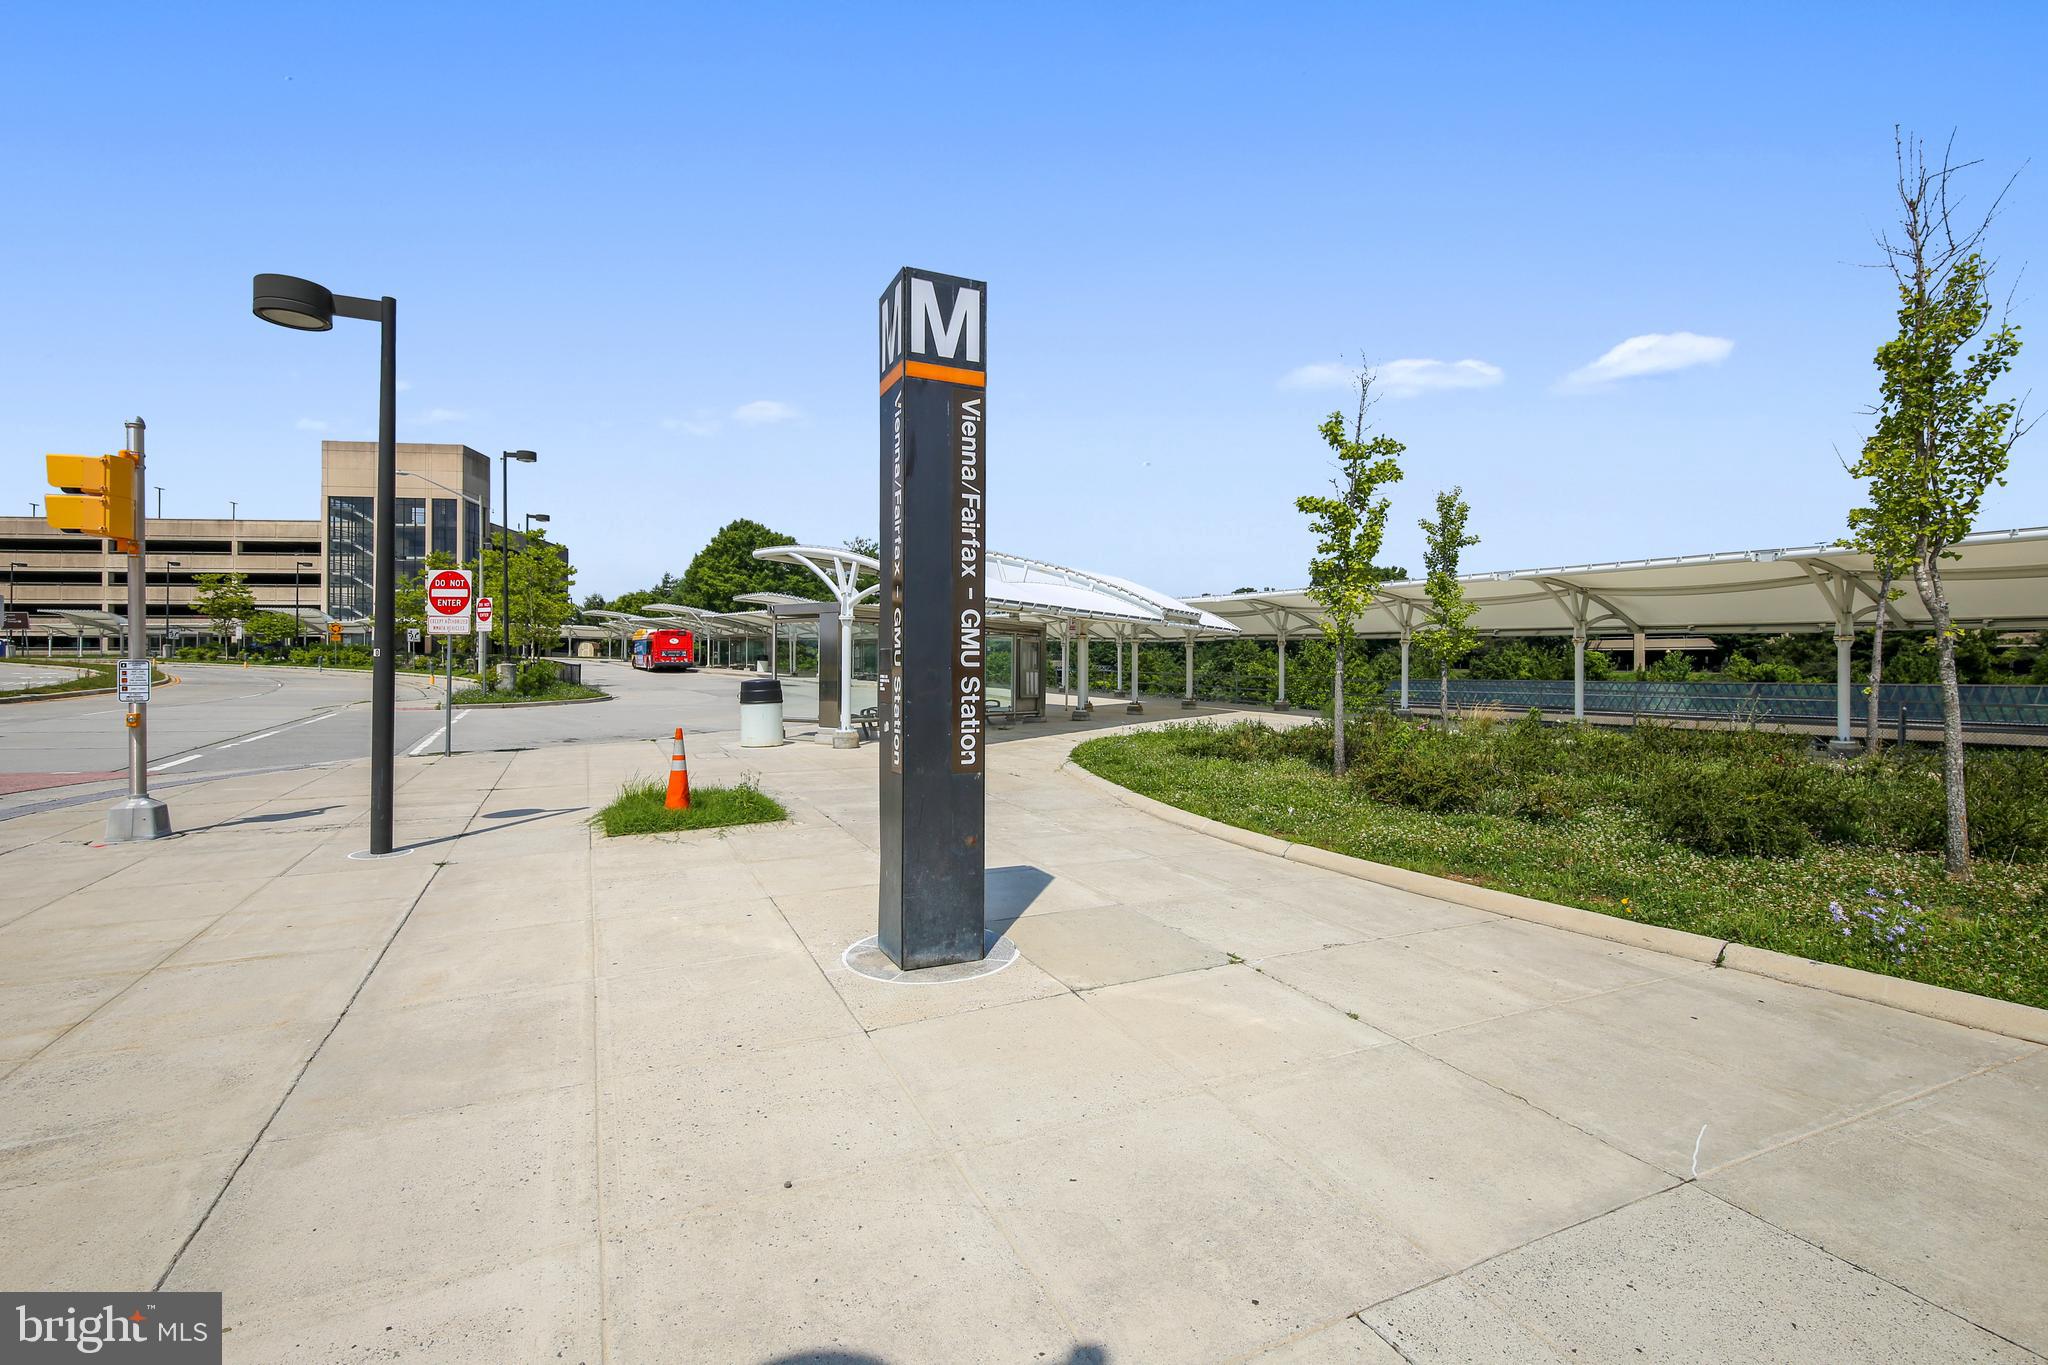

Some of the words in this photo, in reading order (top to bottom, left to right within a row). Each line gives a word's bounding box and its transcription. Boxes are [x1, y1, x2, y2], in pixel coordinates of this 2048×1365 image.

[882, 280, 901, 373] M
[911, 277, 980, 362] M
[961, 398, 981, 578] Vienna/Fairfax
[893, 607, 902, 667] GMU
[960, 608, 981, 668] GMU
[893, 675, 902, 766] Station
[960, 676, 981, 766] Station
